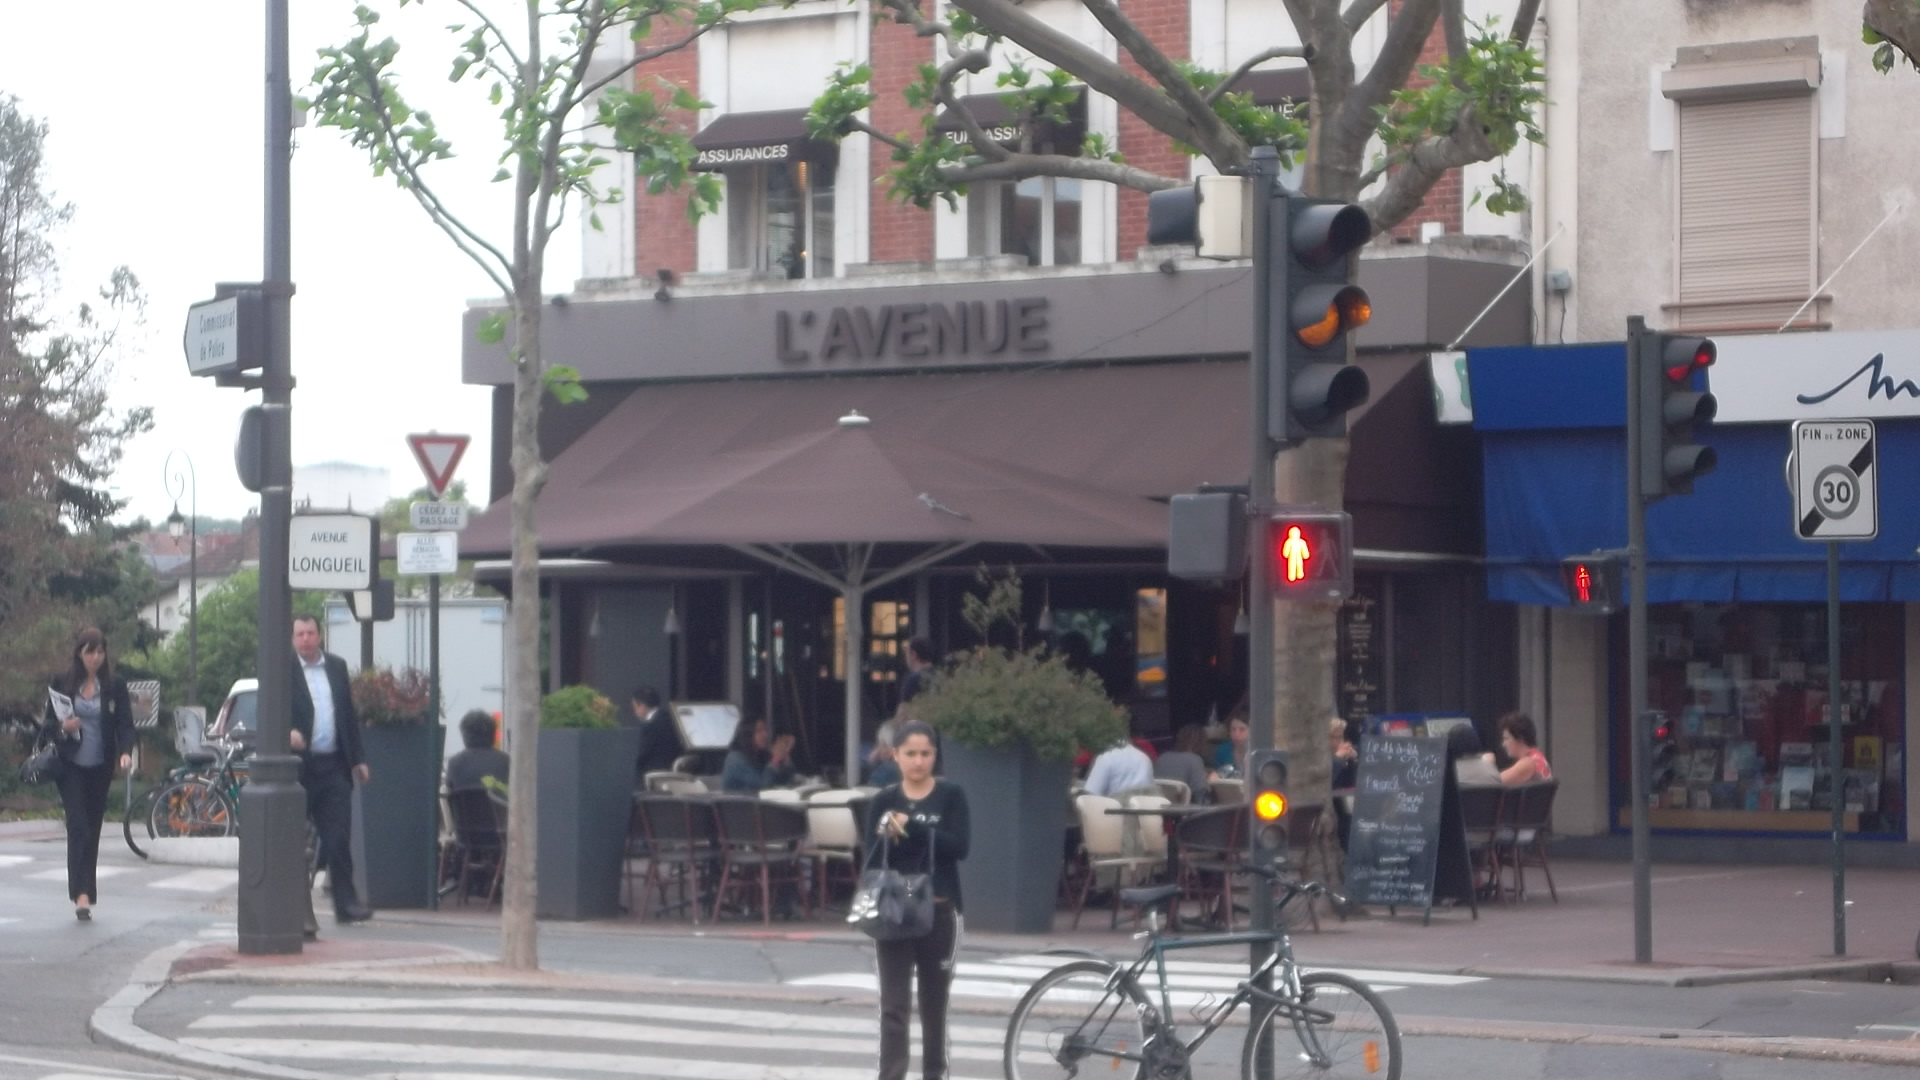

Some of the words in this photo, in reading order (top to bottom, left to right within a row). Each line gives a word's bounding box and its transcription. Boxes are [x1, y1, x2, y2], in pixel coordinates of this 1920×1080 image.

[698, 144, 788, 164] ASSURANCES
[775, 297, 1050, 364] L'AVENUE
[1802, 428, 1821, 440] FIN
[1837, 428, 1867, 440] ZONE
[1822, 481, 1851, 504] 30
[451, 506, 460, 515] LE
[420, 516, 459, 526] PASSAGE
[311, 532, 348, 543] AVENUE
[292, 556, 366, 572] LONGUEIL
